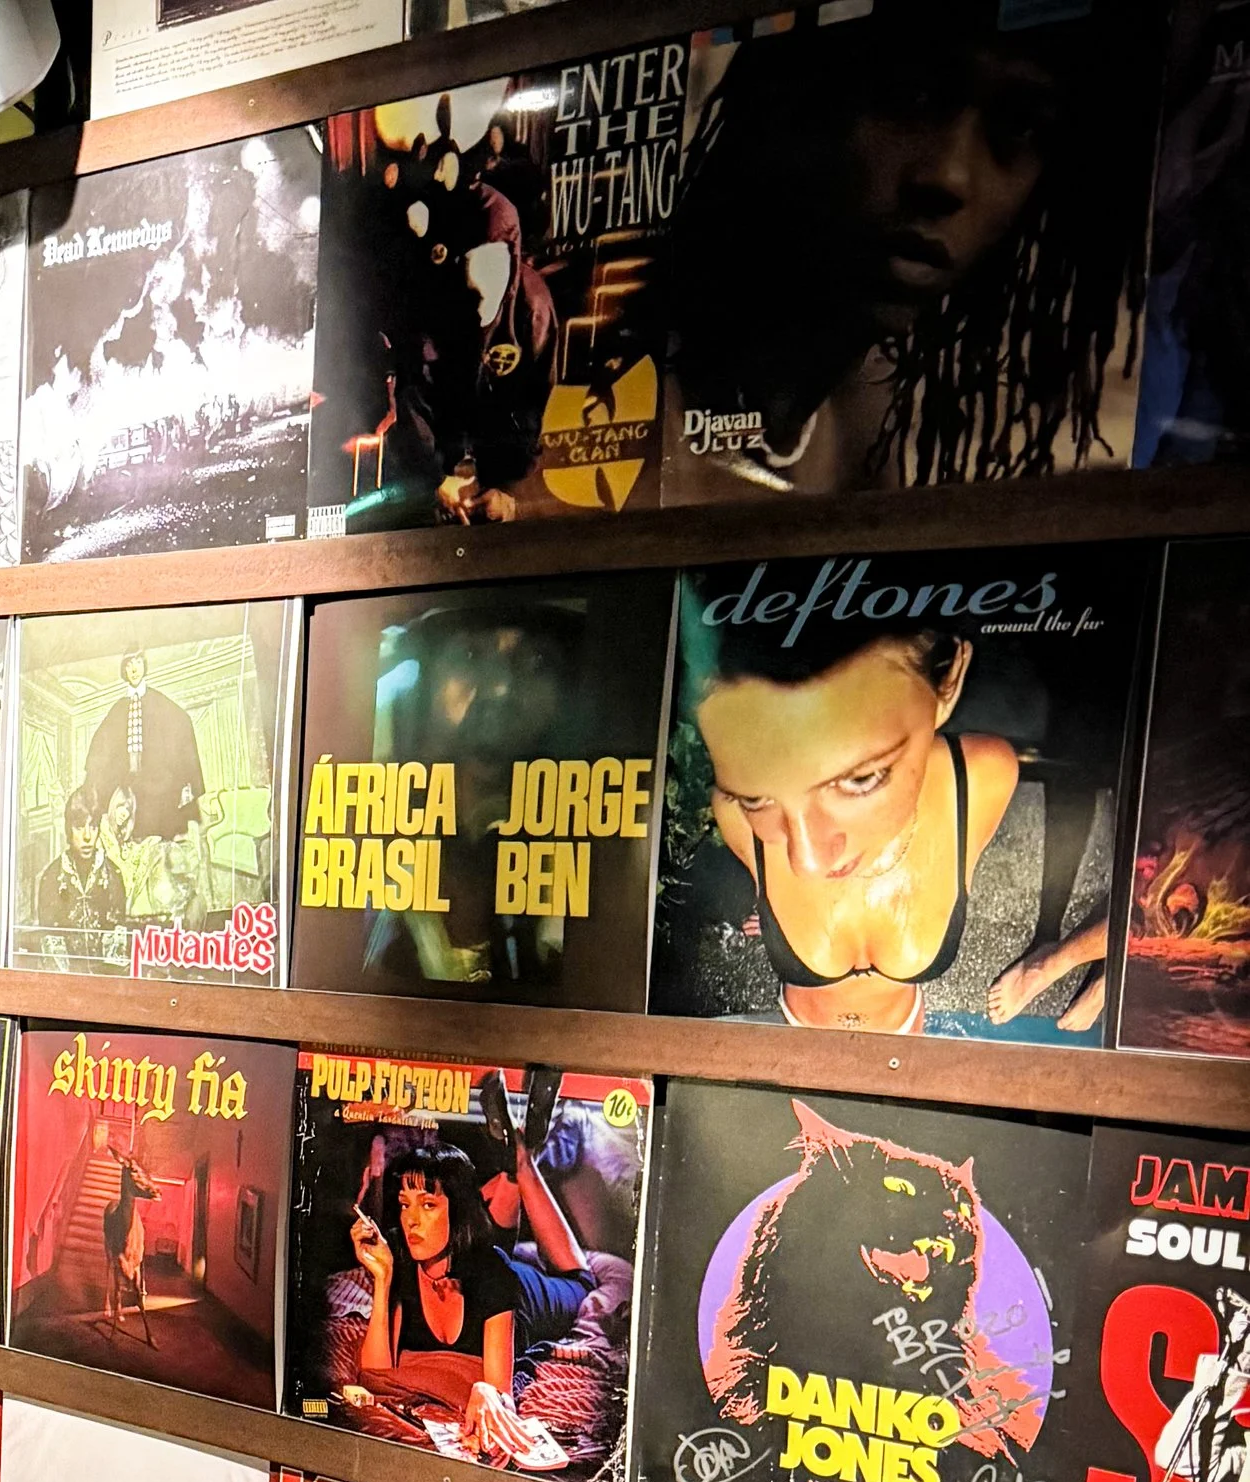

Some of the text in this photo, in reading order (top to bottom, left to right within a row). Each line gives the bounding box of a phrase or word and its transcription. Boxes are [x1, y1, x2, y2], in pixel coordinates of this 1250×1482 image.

[556, 43, 685, 123] ENTER
[555, 101, 680, 156] THE
[551, 138, 677, 239] WU-TANG
[43, 217, 172, 267] Dead Kennedys
[684, 408, 762, 455] Djavan
[713, 434, 762, 451] LUZ
[701, 558, 1057, 649] deftones
[980, 608, 1105, 640] around the fur
[305, 753, 456, 838] ÁFRICA
[496, 756, 652, 838] JORGE
[300, 837, 451, 914] BRASIL
[495, 842, 591, 918] BEN
[131, 917, 278, 980] Mutantes
[49, 1033, 178, 1125] skinty
[311, 1053, 372, 1103] PULP
[373, 1059, 472, 1115] FICTION
[766, 1363, 962, 1449] DANKO
